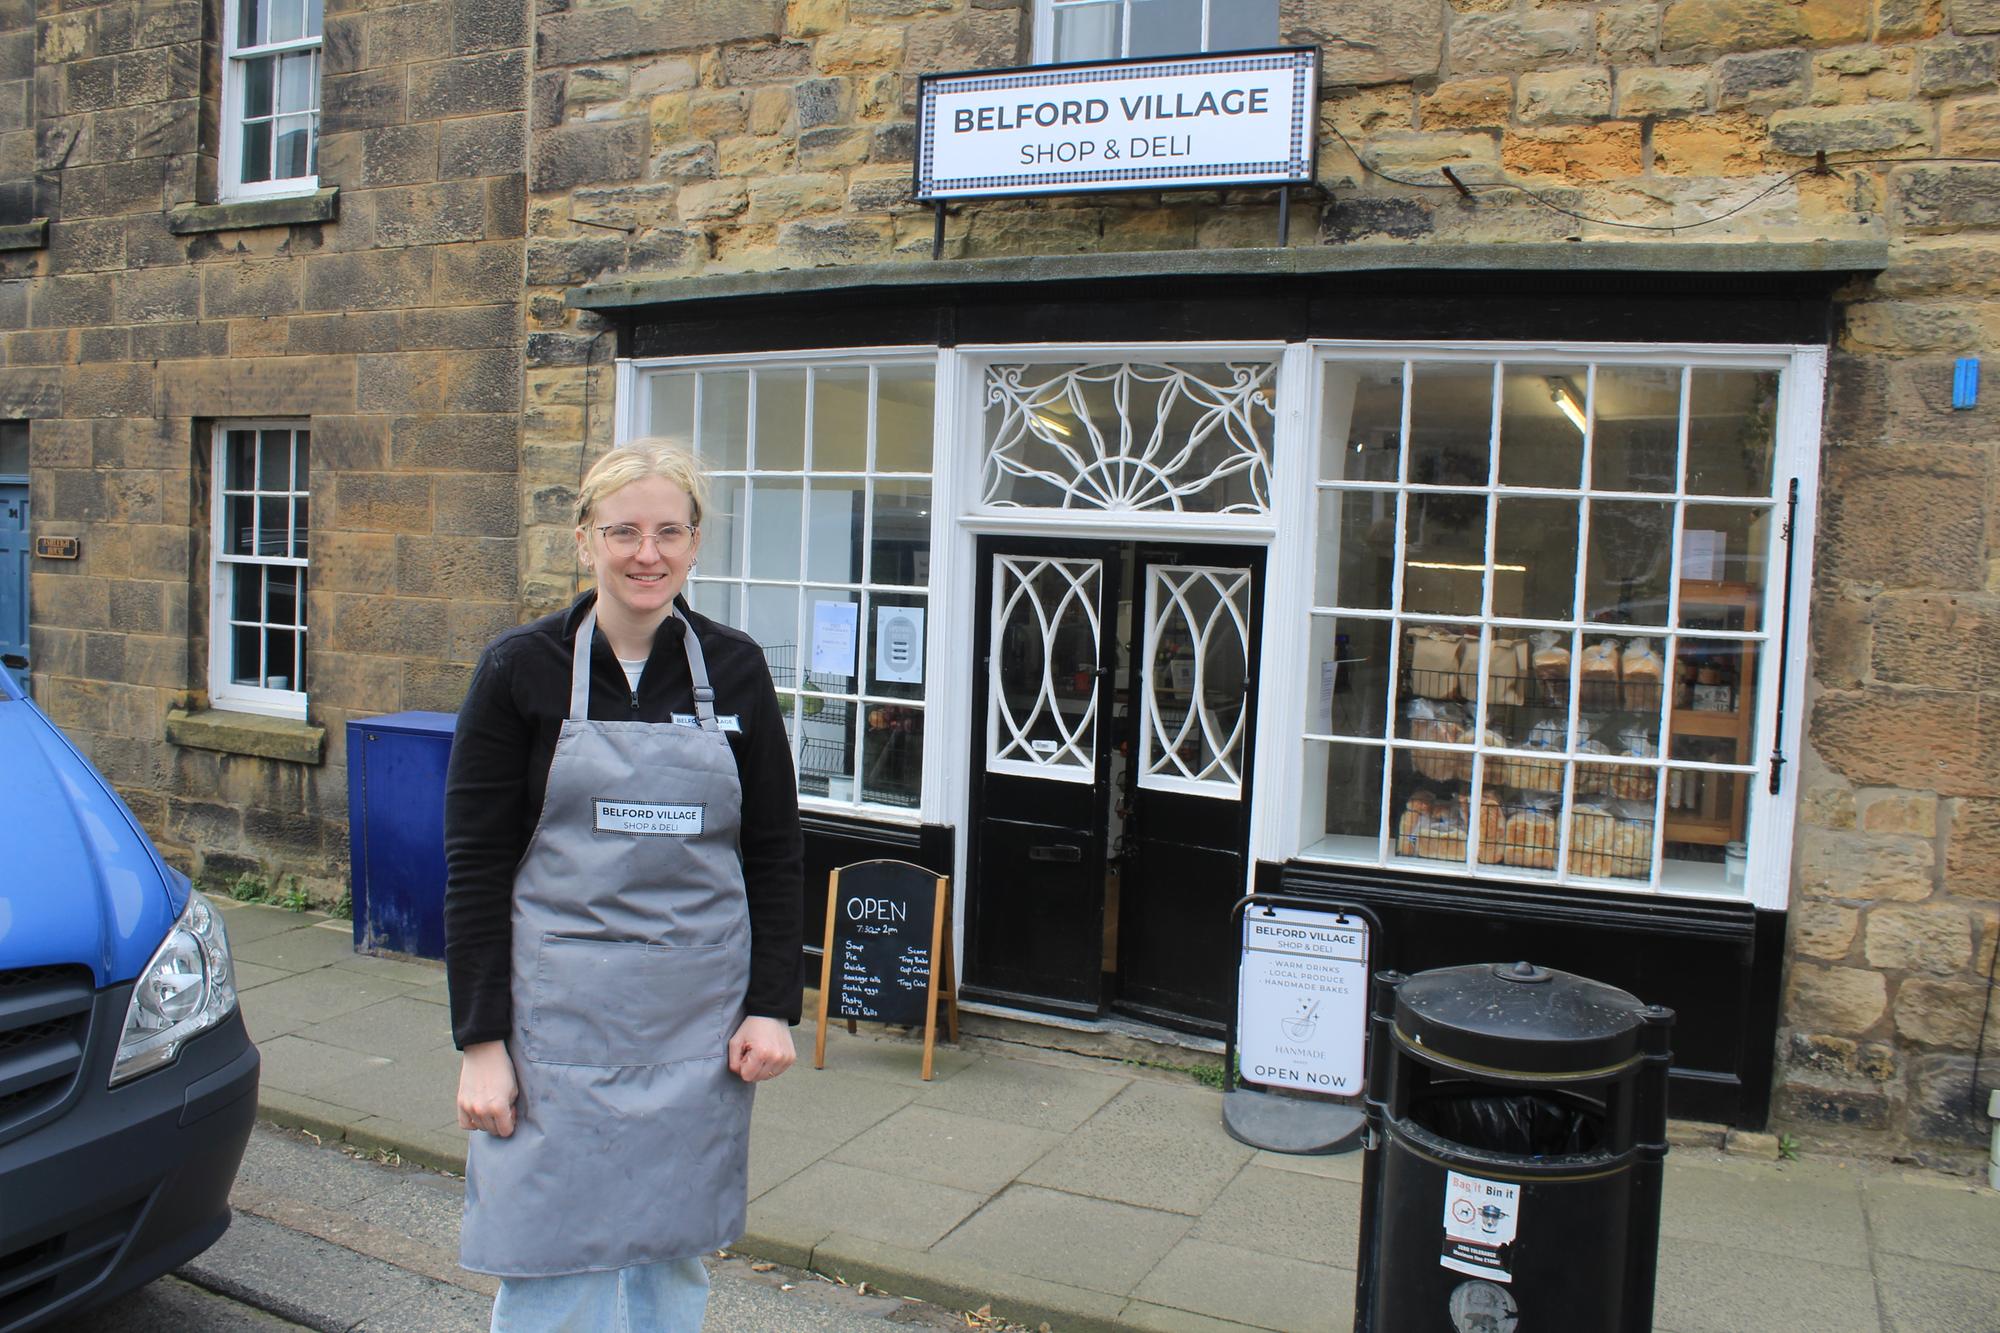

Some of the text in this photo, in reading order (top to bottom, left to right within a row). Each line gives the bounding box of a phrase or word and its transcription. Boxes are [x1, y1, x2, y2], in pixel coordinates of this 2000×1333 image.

[954, 88, 1269, 133] BELFORD VILLAGE
[1020, 135, 1192, 165] SHOP & DELI
[602, 806, 697, 820] BELFORD VILLAGE
[623, 821, 678, 832] SHOP & DELI
[846, 897, 906, 922] OPEN
[882, 924, 898, 935] 2pm
[1255, 925, 1356, 945] BELFORD VILLAGE
[845, 940, 864, 952] Soup
[907, 946, 927, 956] Scone
[1278, 940, 1333, 953] SHOP & DELI
[845, 951, 858, 961] Pie
[898, 955, 914, 965] Tray
[843, 962, 867, 973] Quiche
[900, 966, 930, 975] Cup Cakes
[1275, 960, 1341, 974] WARM DRINKS
[1269, 970, 1345, 985] LOCAL PRODUCE
[897, 979, 913, 990] Tray
[1264, 979, 1350, 995] HANDMADE BAKES
[864, 987, 879, 996] eggs
[841, 992, 863, 1007] Pasty
[841, 1005, 860, 1016] Filled
[1254, 1065, 1347, 1087] OPEN NOW
[1453, 1177, 1514, 1199] Bag it Bin it
